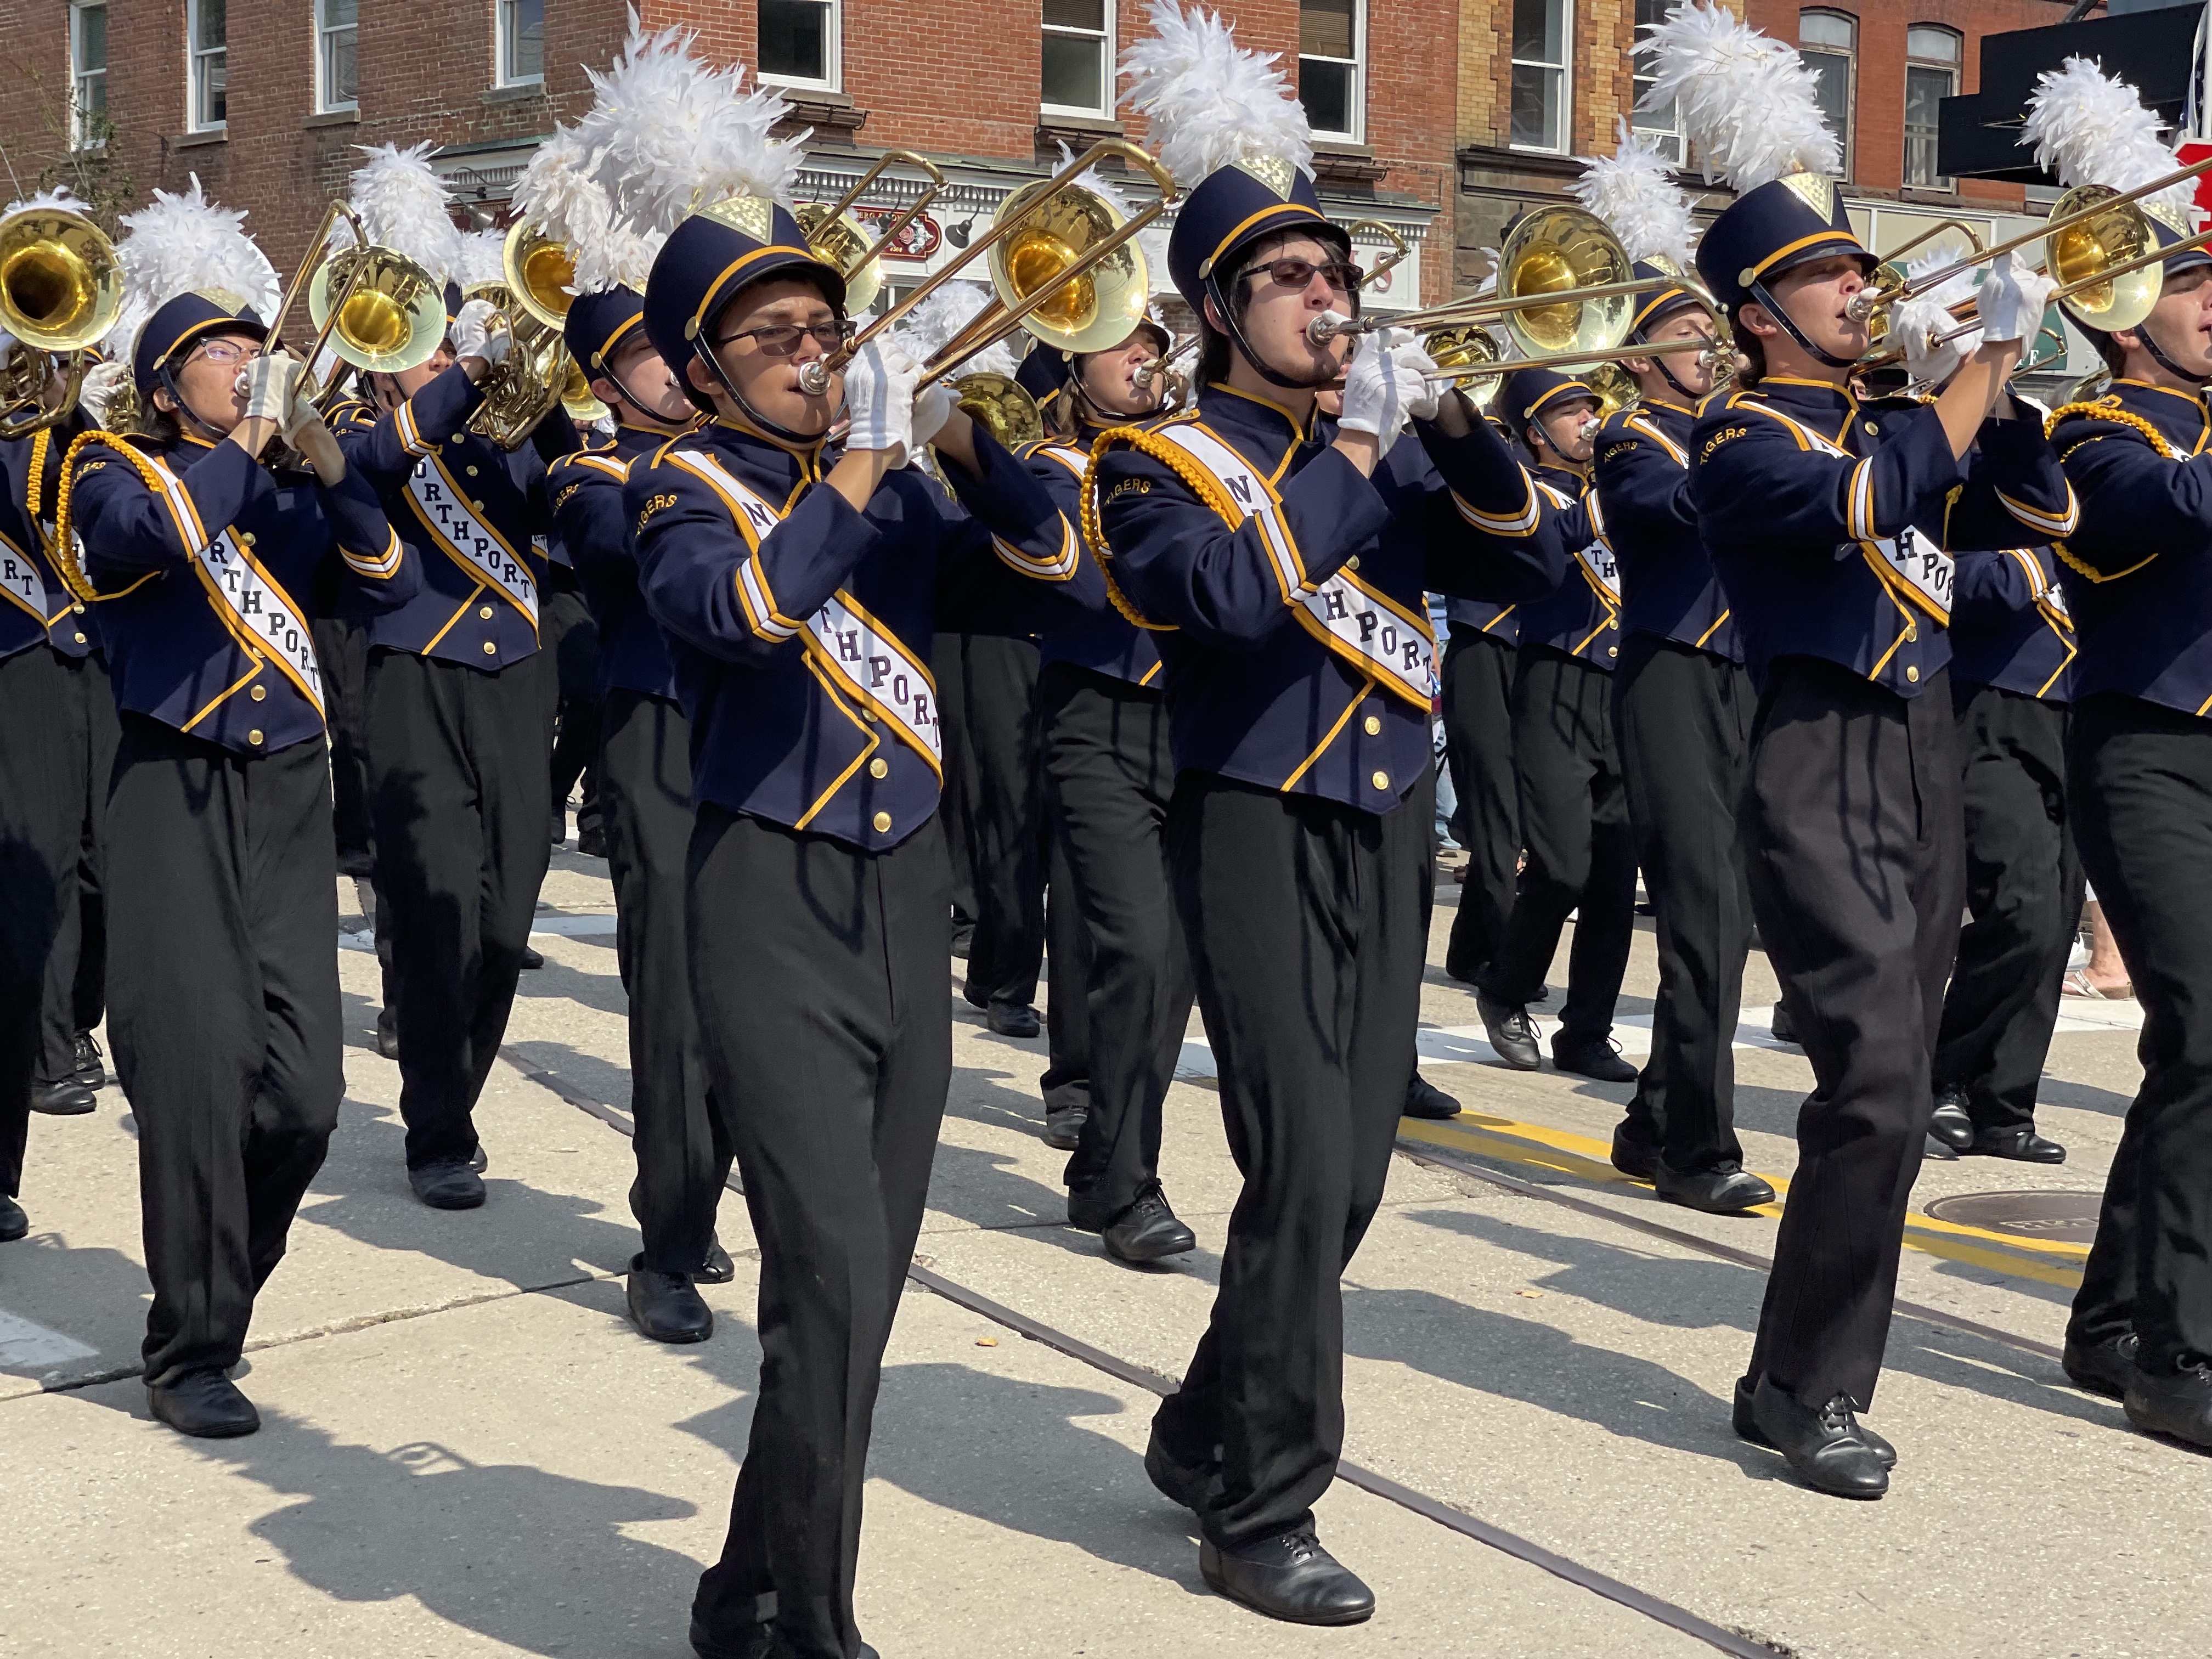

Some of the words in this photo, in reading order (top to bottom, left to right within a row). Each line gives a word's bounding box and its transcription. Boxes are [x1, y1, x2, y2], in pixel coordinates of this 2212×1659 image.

[1700, 427, 1747, 465] TIGERS
[414, 461, 530, 599] ORTHPORT
[1591, 543, 1616, 578] TH
